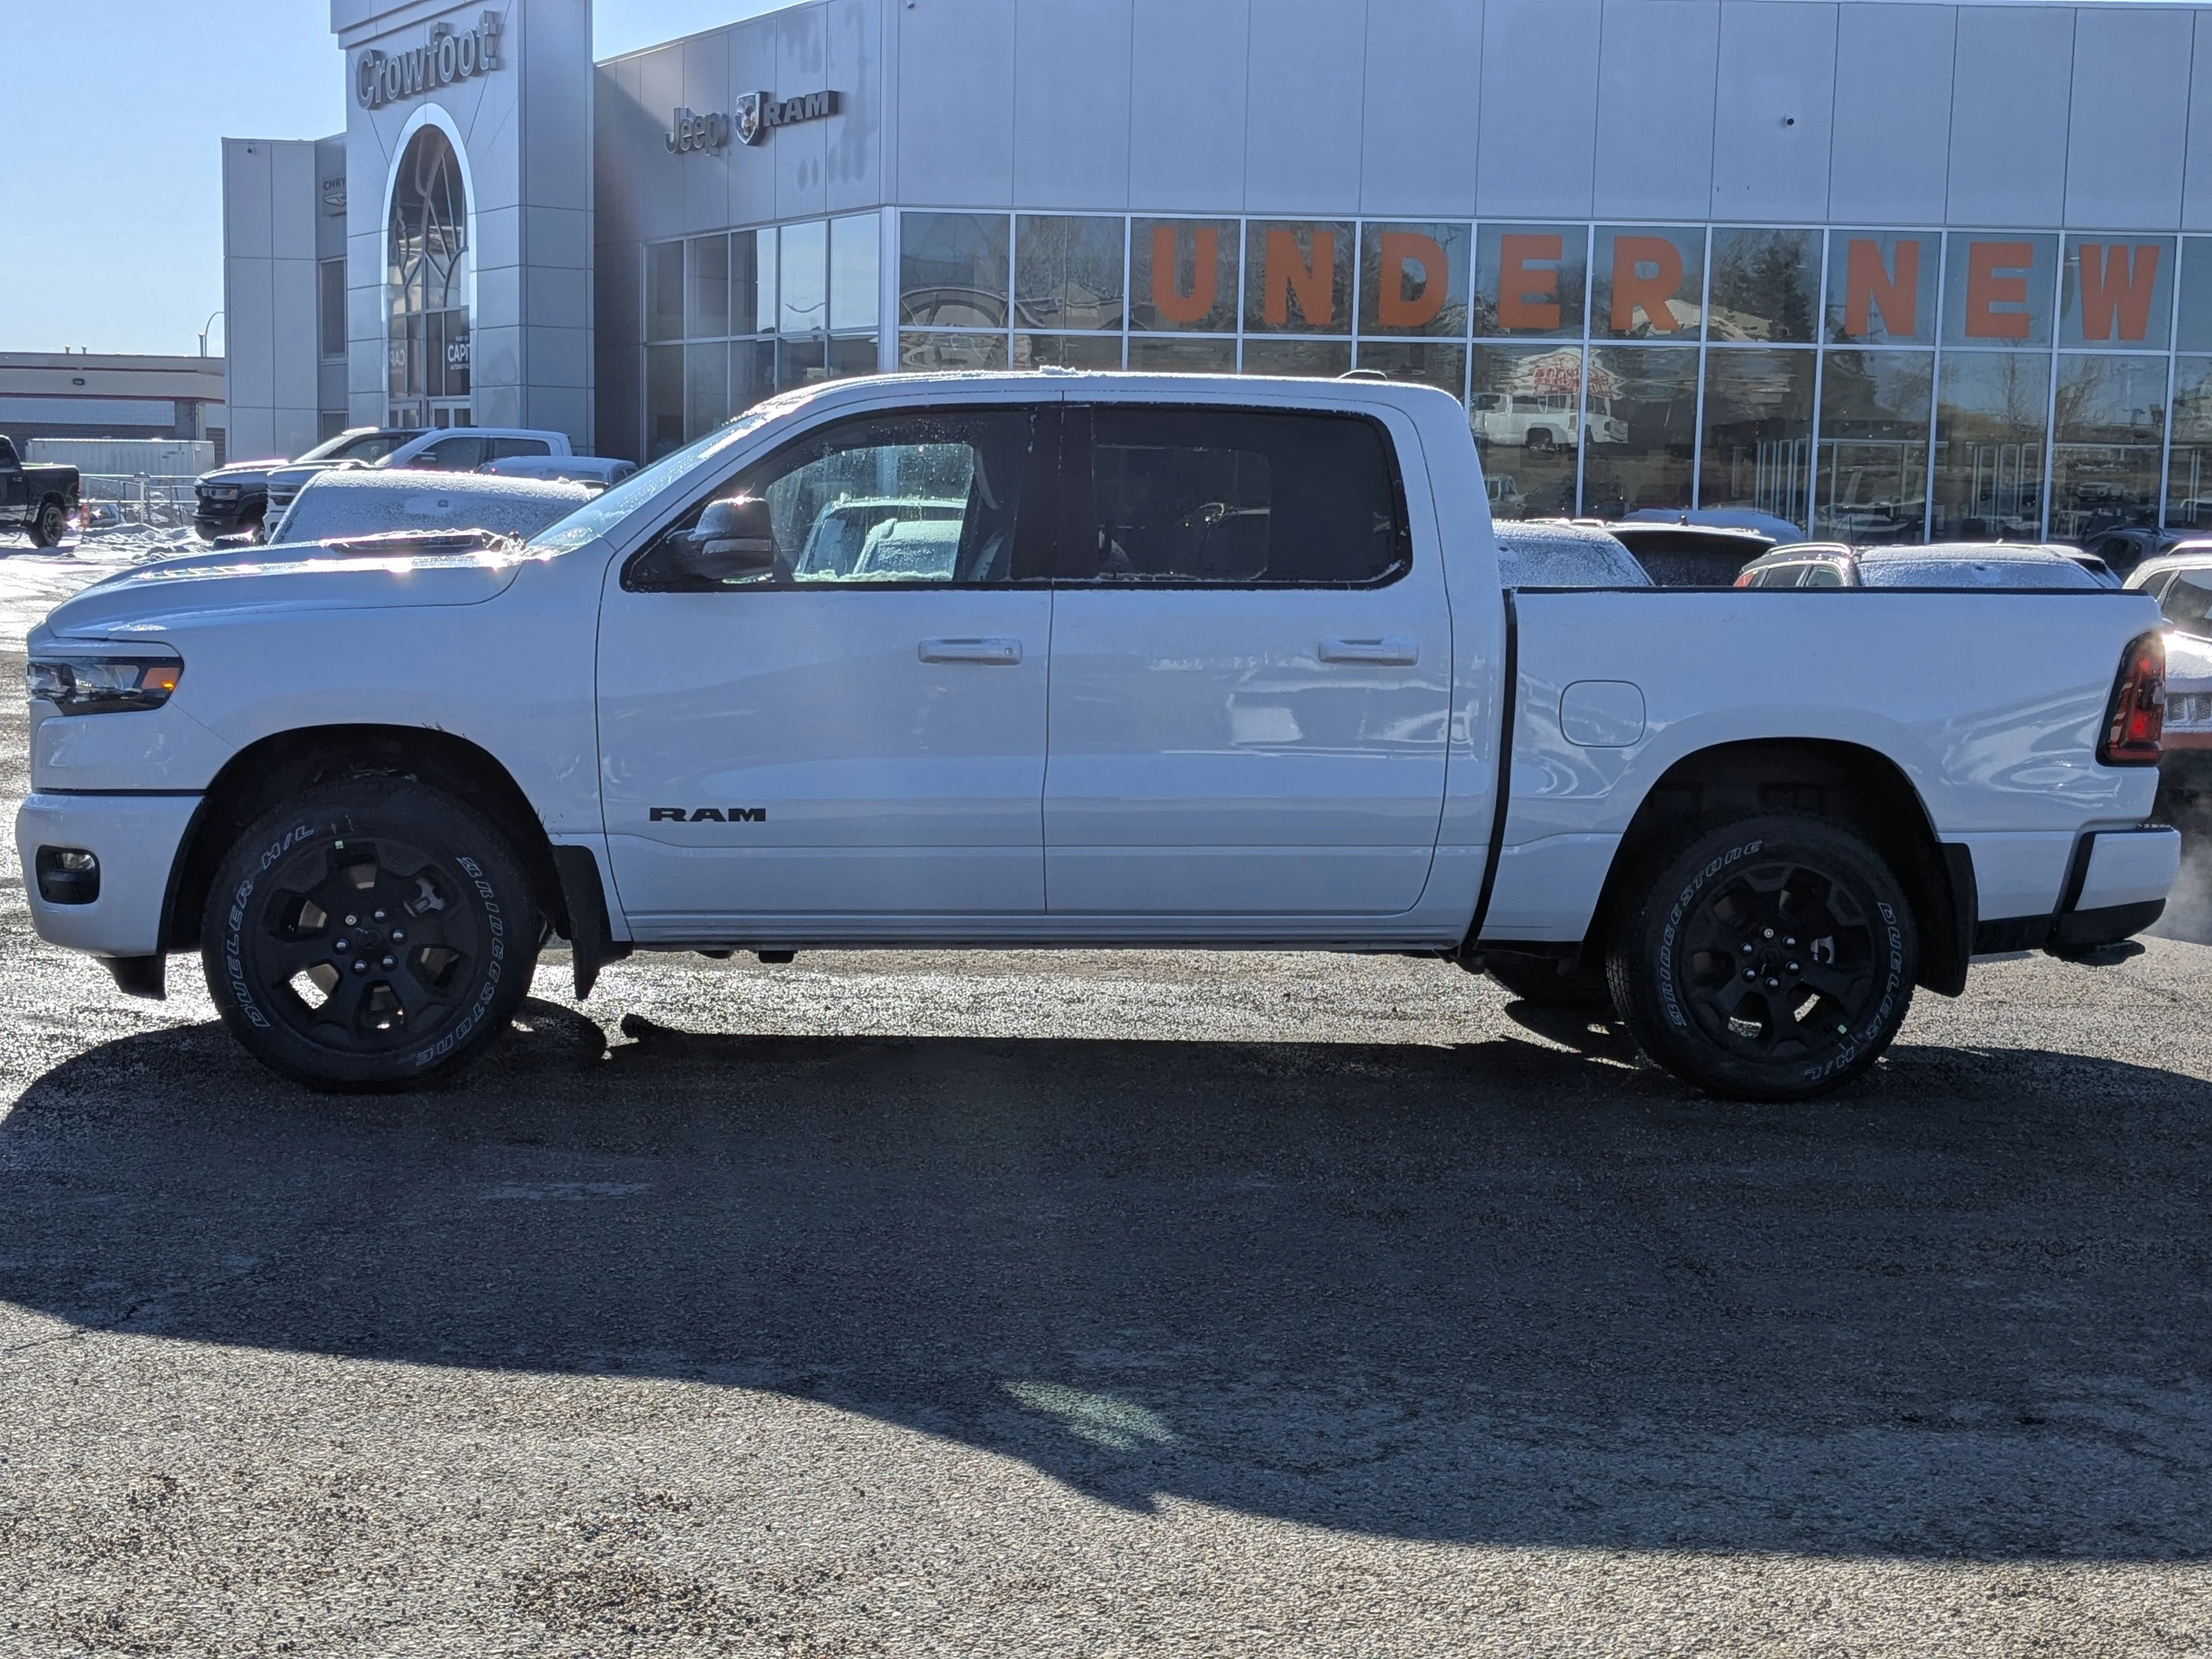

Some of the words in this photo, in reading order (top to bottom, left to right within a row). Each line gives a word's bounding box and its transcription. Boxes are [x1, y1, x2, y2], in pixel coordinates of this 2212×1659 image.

[357, 10, 497, 110] Crowfoot
[763, 90, 835, 127] RAM
[664, 108, 726, 156] Jeep
[1152, 227, 1683, 330] UNDER
[1845, 239, 2161, 341] NEW
[650, 808, 766, 822] RAM
[227, 880, 270, 1028] DUELER
[261, 826, 314, 870] H/L
[416, 856, 504, 1066] BRIDGESTONE
[1660, 840, 1763, 1027] BRIDGESTONE
[1866, 902, 1902, 1040] DUELER
